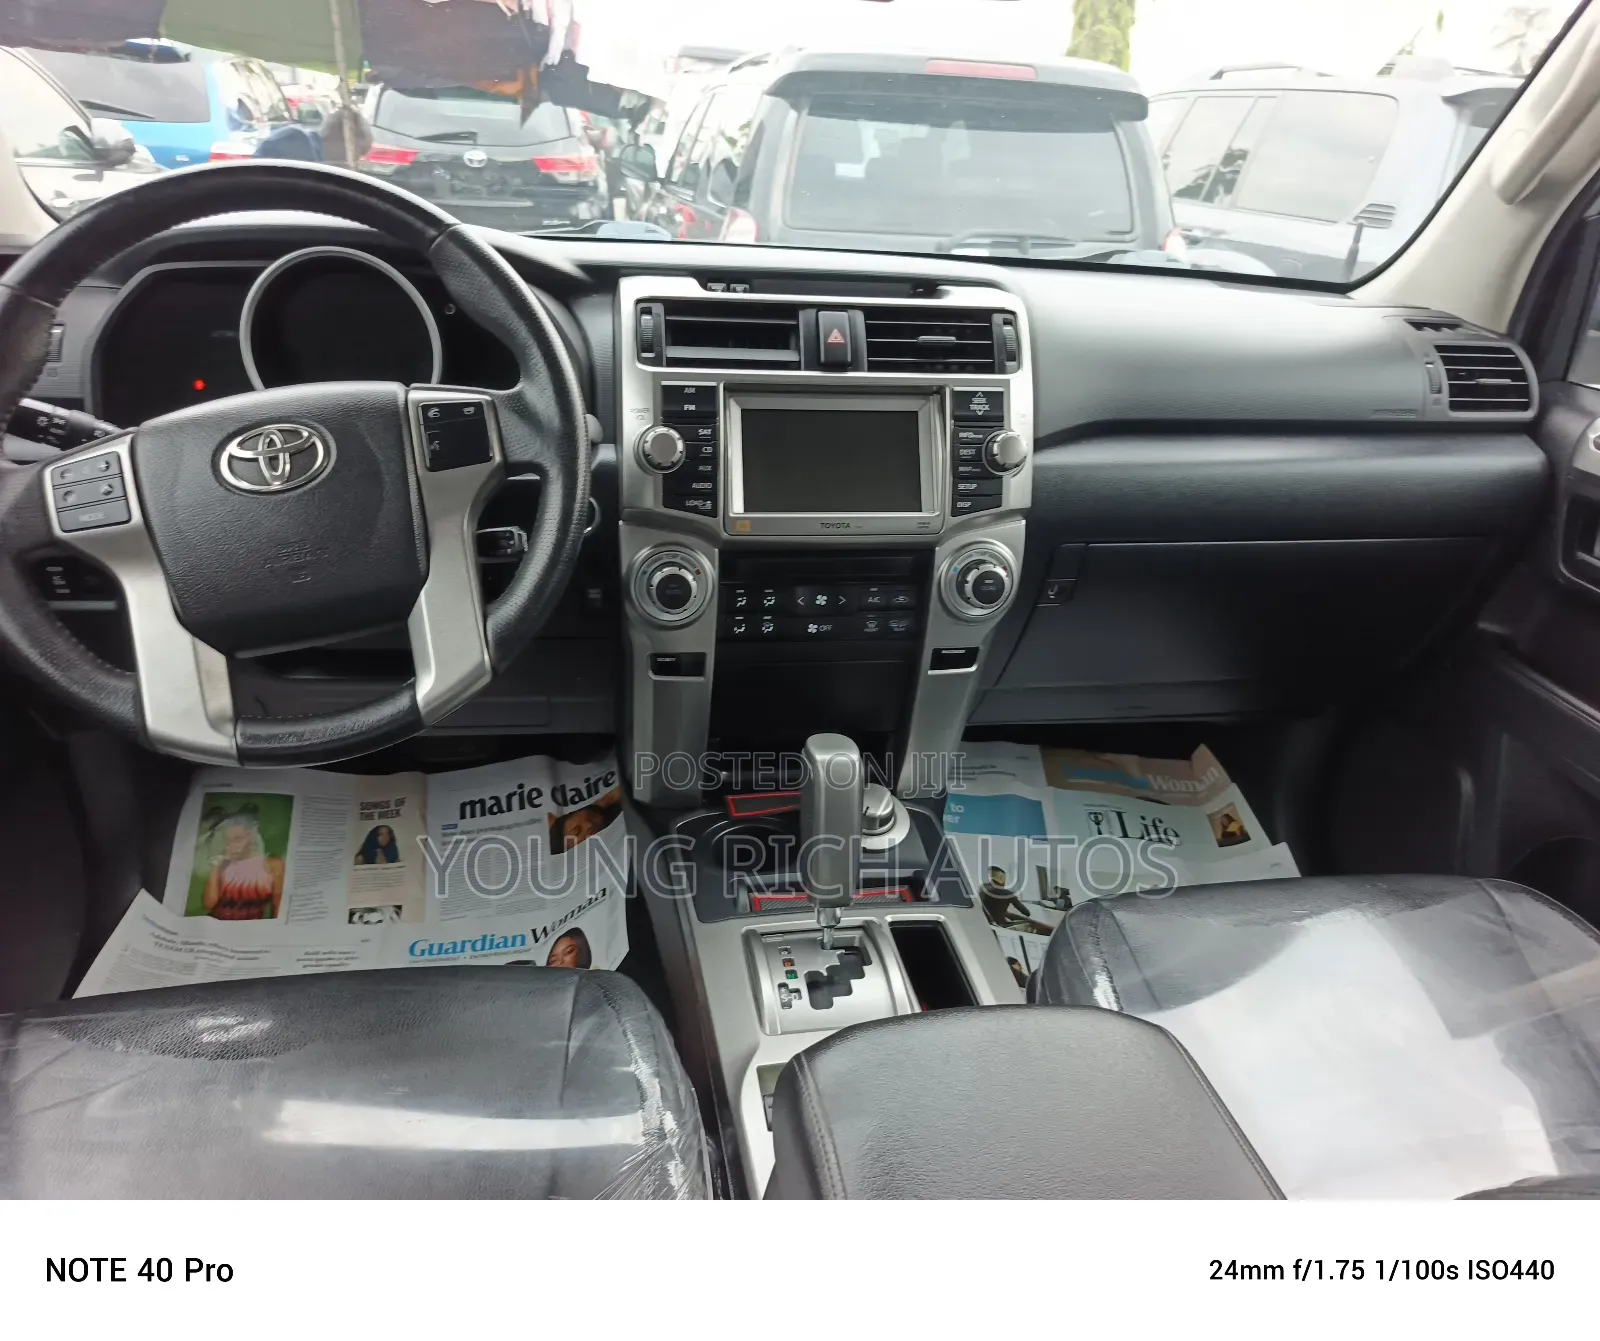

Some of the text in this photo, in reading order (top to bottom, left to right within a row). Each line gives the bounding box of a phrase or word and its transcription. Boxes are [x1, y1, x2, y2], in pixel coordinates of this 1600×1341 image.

[820, 522, 851, 530] TOYOTA
[819, 624, 833, 632] OFF
[1146, 765, 1220, 793] Woman
[459, 783, 544, 820] marie
[950, 802, 965, 813] to
[378, 808, 402, 820] WEEK
[1111, 808, 1181, 847] Life
[408, 933, 527, 957] Guardian
[530, 886, 608, 945] Woman
